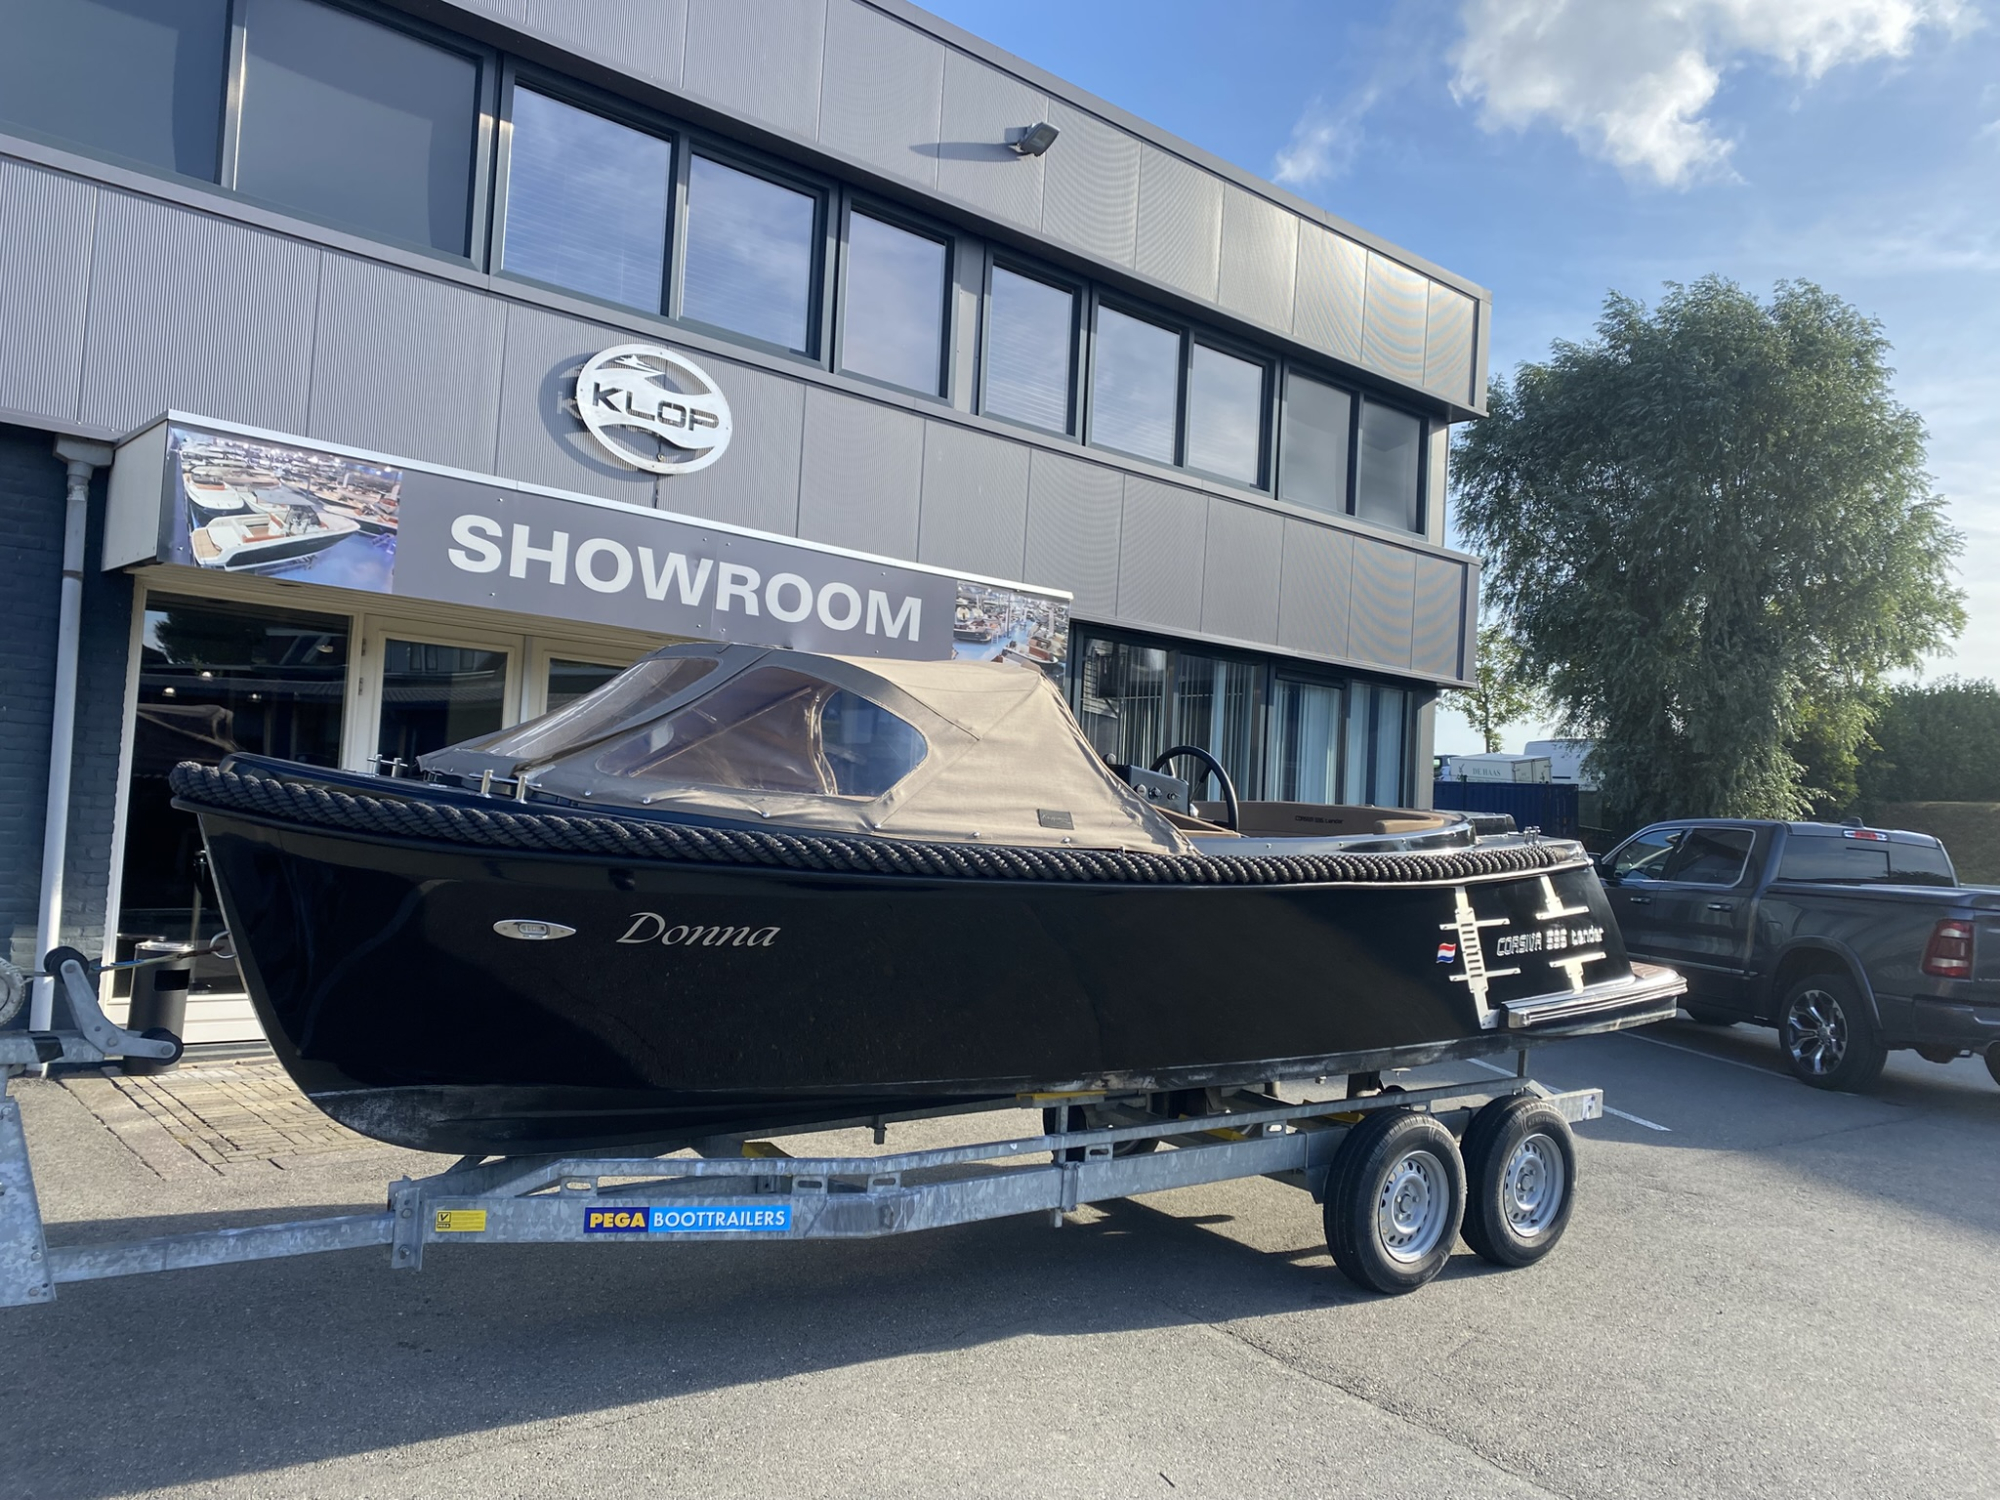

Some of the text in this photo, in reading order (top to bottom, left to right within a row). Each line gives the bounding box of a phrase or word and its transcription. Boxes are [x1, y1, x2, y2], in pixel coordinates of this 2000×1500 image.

[592, 381, 720, 432] KLOP
[447, 513, 922, 642] SHOWROOM
[616, 912, 781, 947] Donna
[1496, 931, 1543, 957] CORSIVA
[589, 1210, 786, 1229] PEGA BOOTTRAILERS
